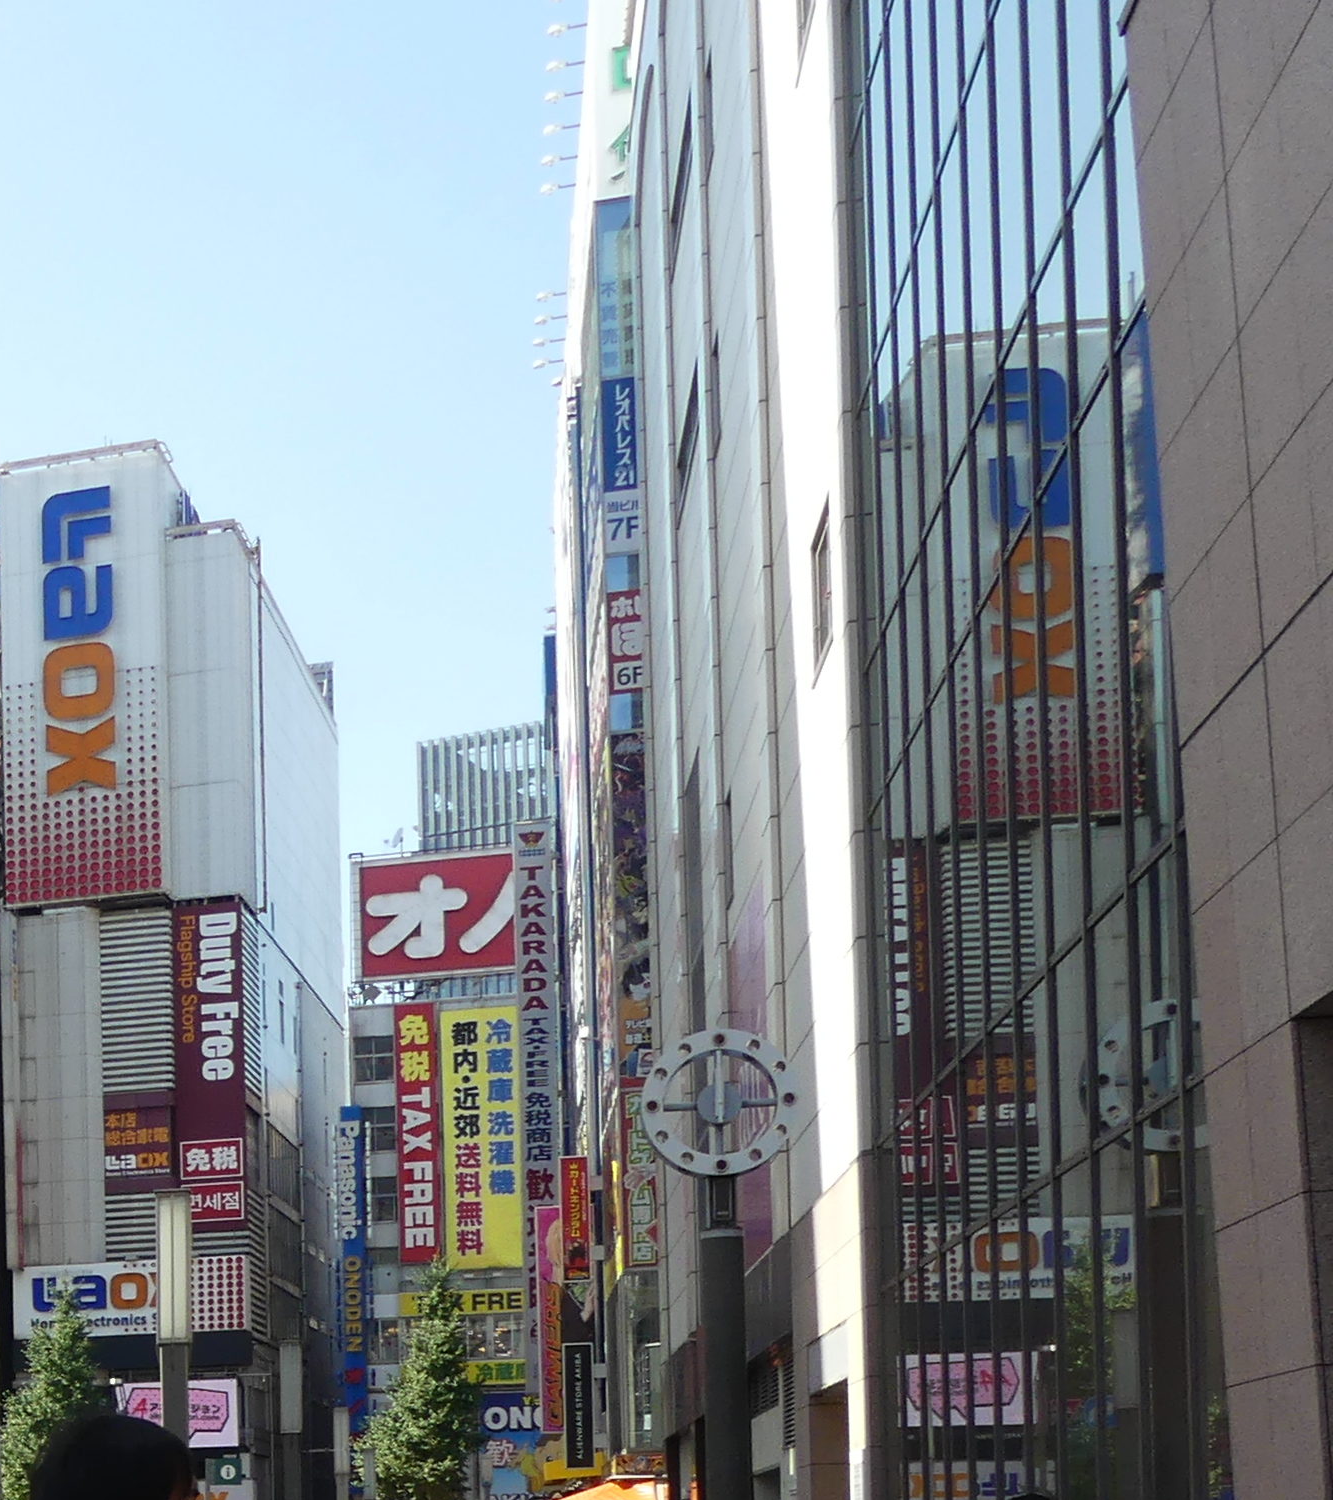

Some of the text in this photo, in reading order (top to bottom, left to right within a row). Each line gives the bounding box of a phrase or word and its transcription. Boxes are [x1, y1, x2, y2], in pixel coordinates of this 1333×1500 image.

[617, 666, 644, 688] 6F
[366, 872, 515, 960] オノ
[519, 865, 549, 1011] TAKARADA
[178, 914, 198, 1045] Flagship Store
[197, 912, 241, 1083] Duty Free
[399, 1014, 431, 1084] 免税
[185, 1145, 239, 1172] 免税
[485, 1018, 516, 1196] 冷蔵庫洗濯機
[334, 1119, 362, 1241] Panasonic
[400, 1086, 436, 1250] TAX FREE
[342, 1254, 363, 1353] ONODEN
[484, 1405, 541, 1430] ON
